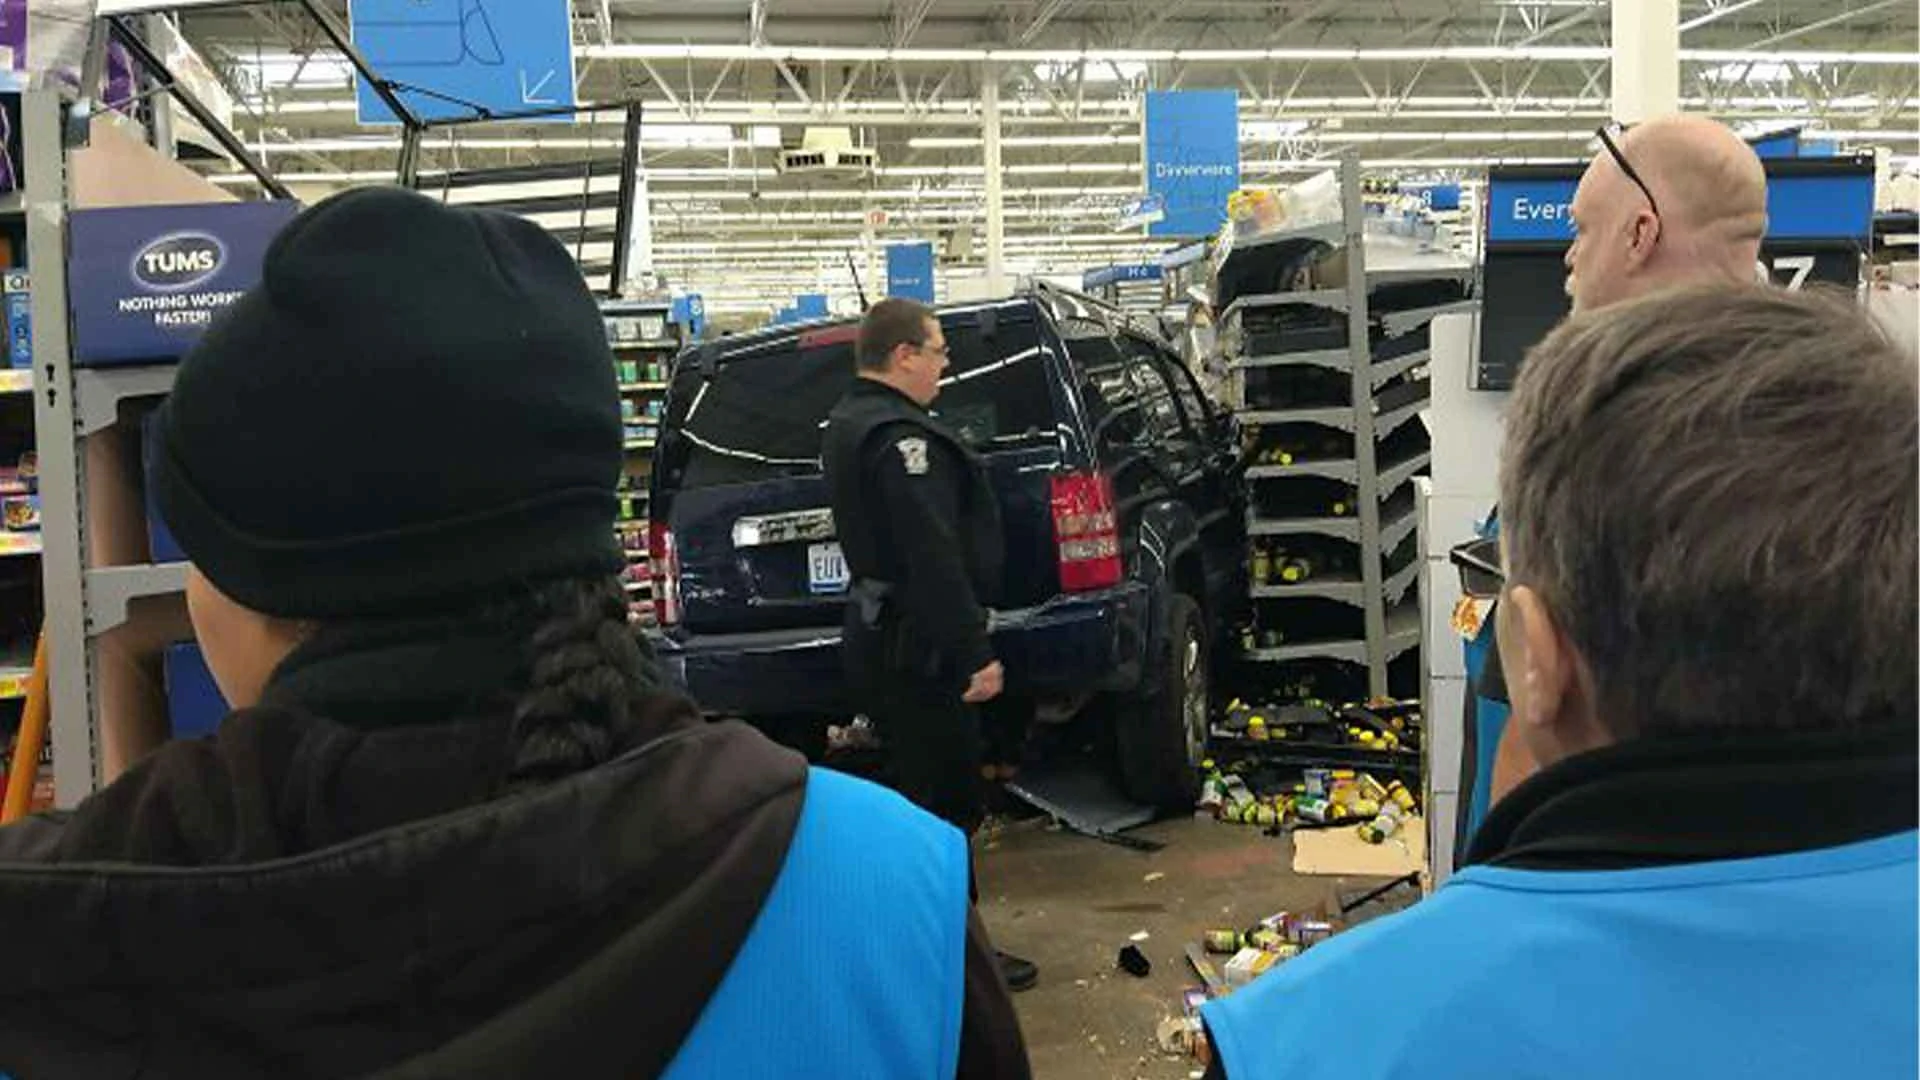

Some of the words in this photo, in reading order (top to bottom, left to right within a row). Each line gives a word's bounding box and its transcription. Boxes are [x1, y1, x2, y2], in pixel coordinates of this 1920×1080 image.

[1155, 162, 1233, 177] Dinnerware
[144, 249, 214, 273] TUMS
[119, 295, 188, 312] NOTHING
